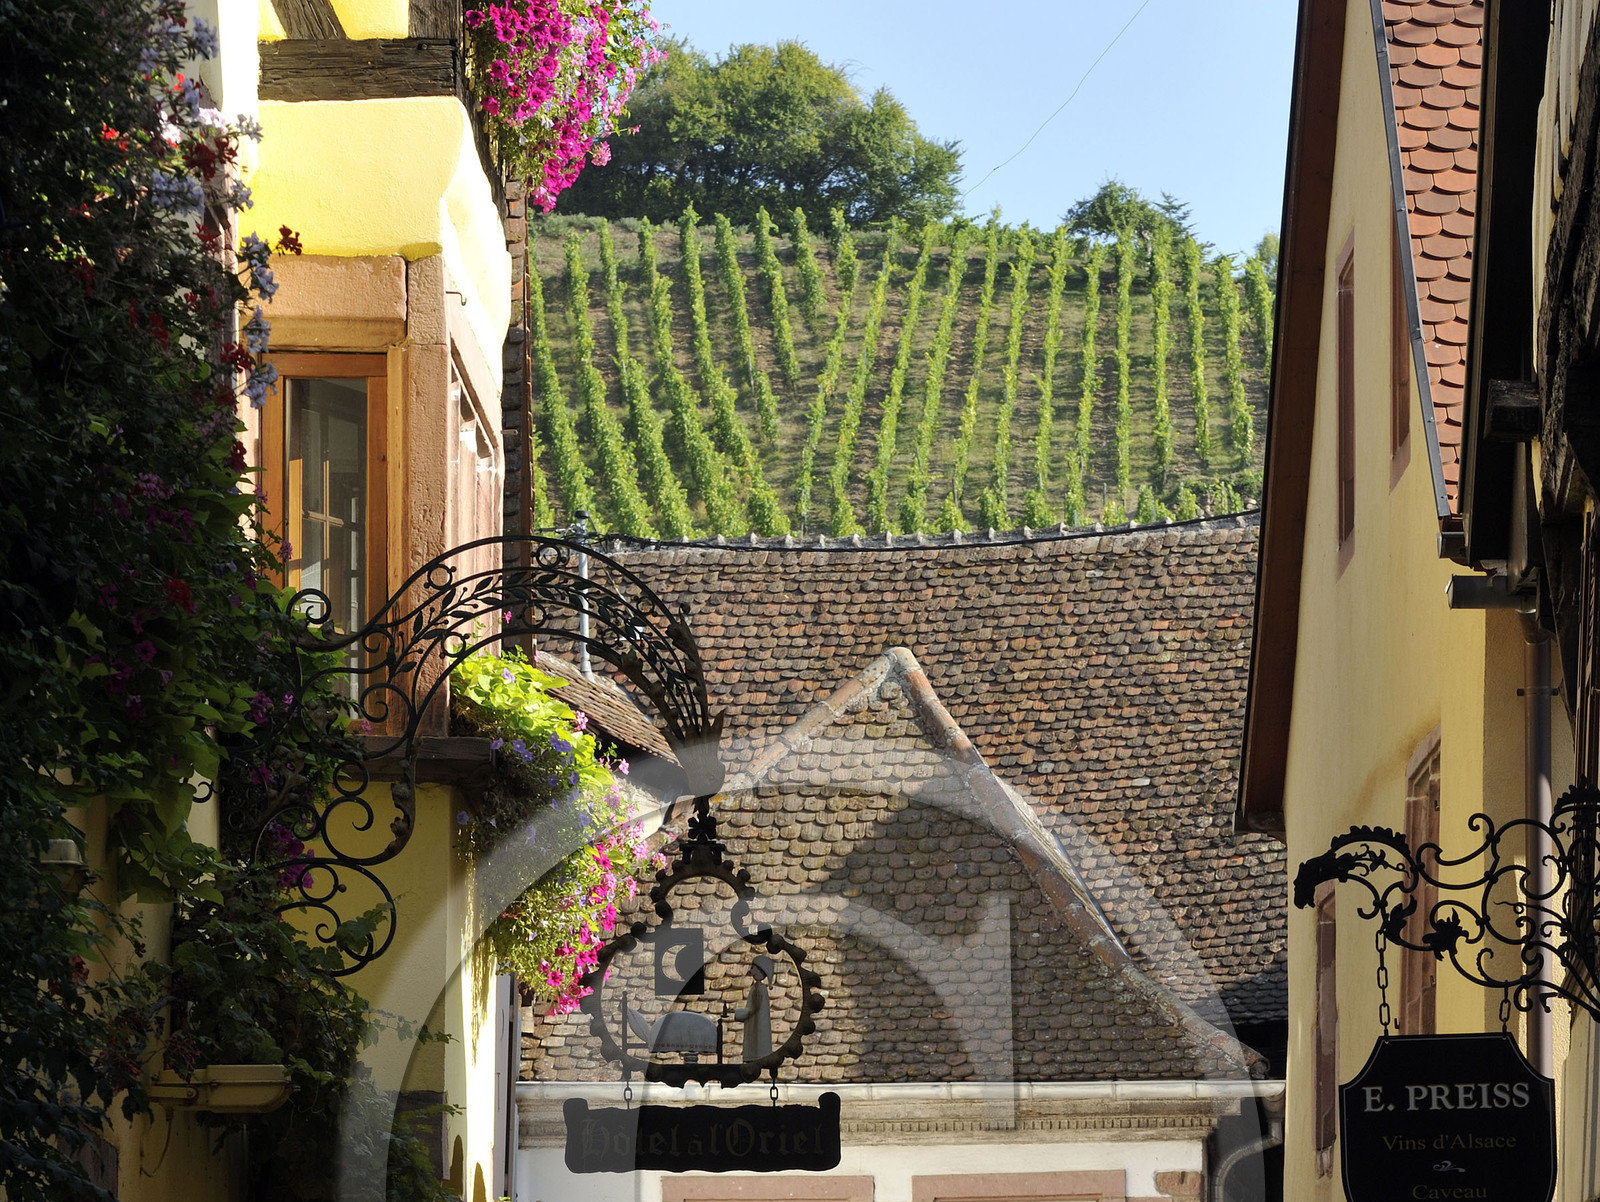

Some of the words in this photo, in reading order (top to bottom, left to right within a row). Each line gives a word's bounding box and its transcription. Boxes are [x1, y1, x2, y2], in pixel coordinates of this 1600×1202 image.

[1361, 1085, 1396, 1112] E.
[1405, 1082, 1530, 1112] PREISS
[1382, 1134, 1427, 1151] Vins
[1433, 1133, 1517, 1150] d'Alsace
[1411, 1184, 1488, 1200] Caveau
